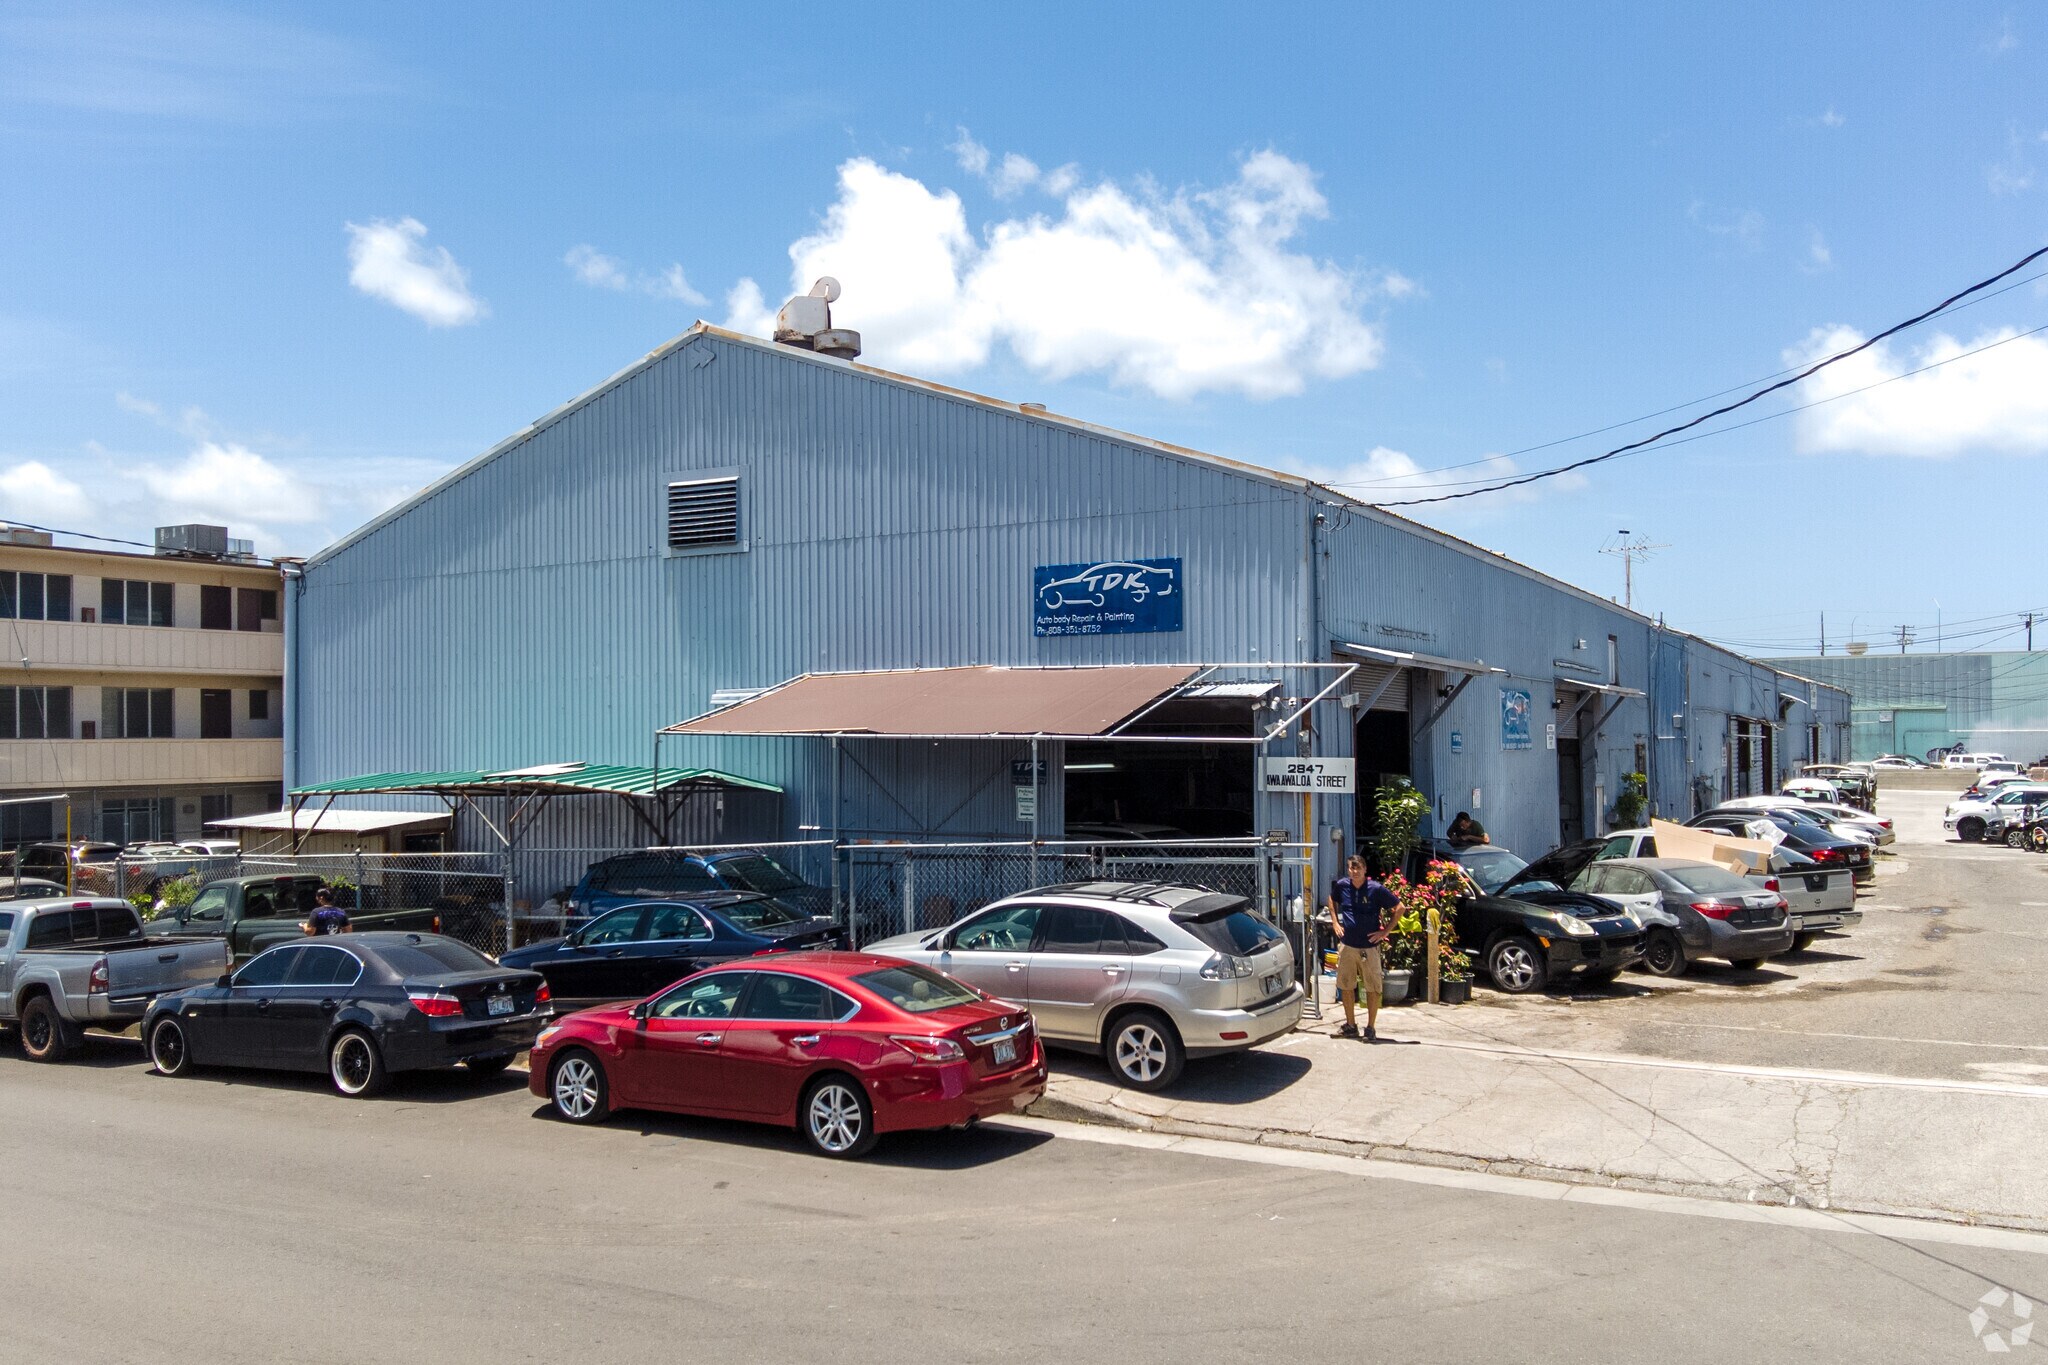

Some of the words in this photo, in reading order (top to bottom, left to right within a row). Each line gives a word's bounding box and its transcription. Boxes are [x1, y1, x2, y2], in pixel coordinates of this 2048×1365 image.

[1083, 572, 1146, 592] TDK
[1036, 616, 1052, 624] Auto
[1053, 615, 1071, 625] body
[1071, 614, 1095, 625] Repair
[1096, 613, 1103, 621] &
[1104, 612, 1135, 622] Painting
[1287, 764, 1324, 774] 2847
[1316, 776, 1347, 788] STREET
